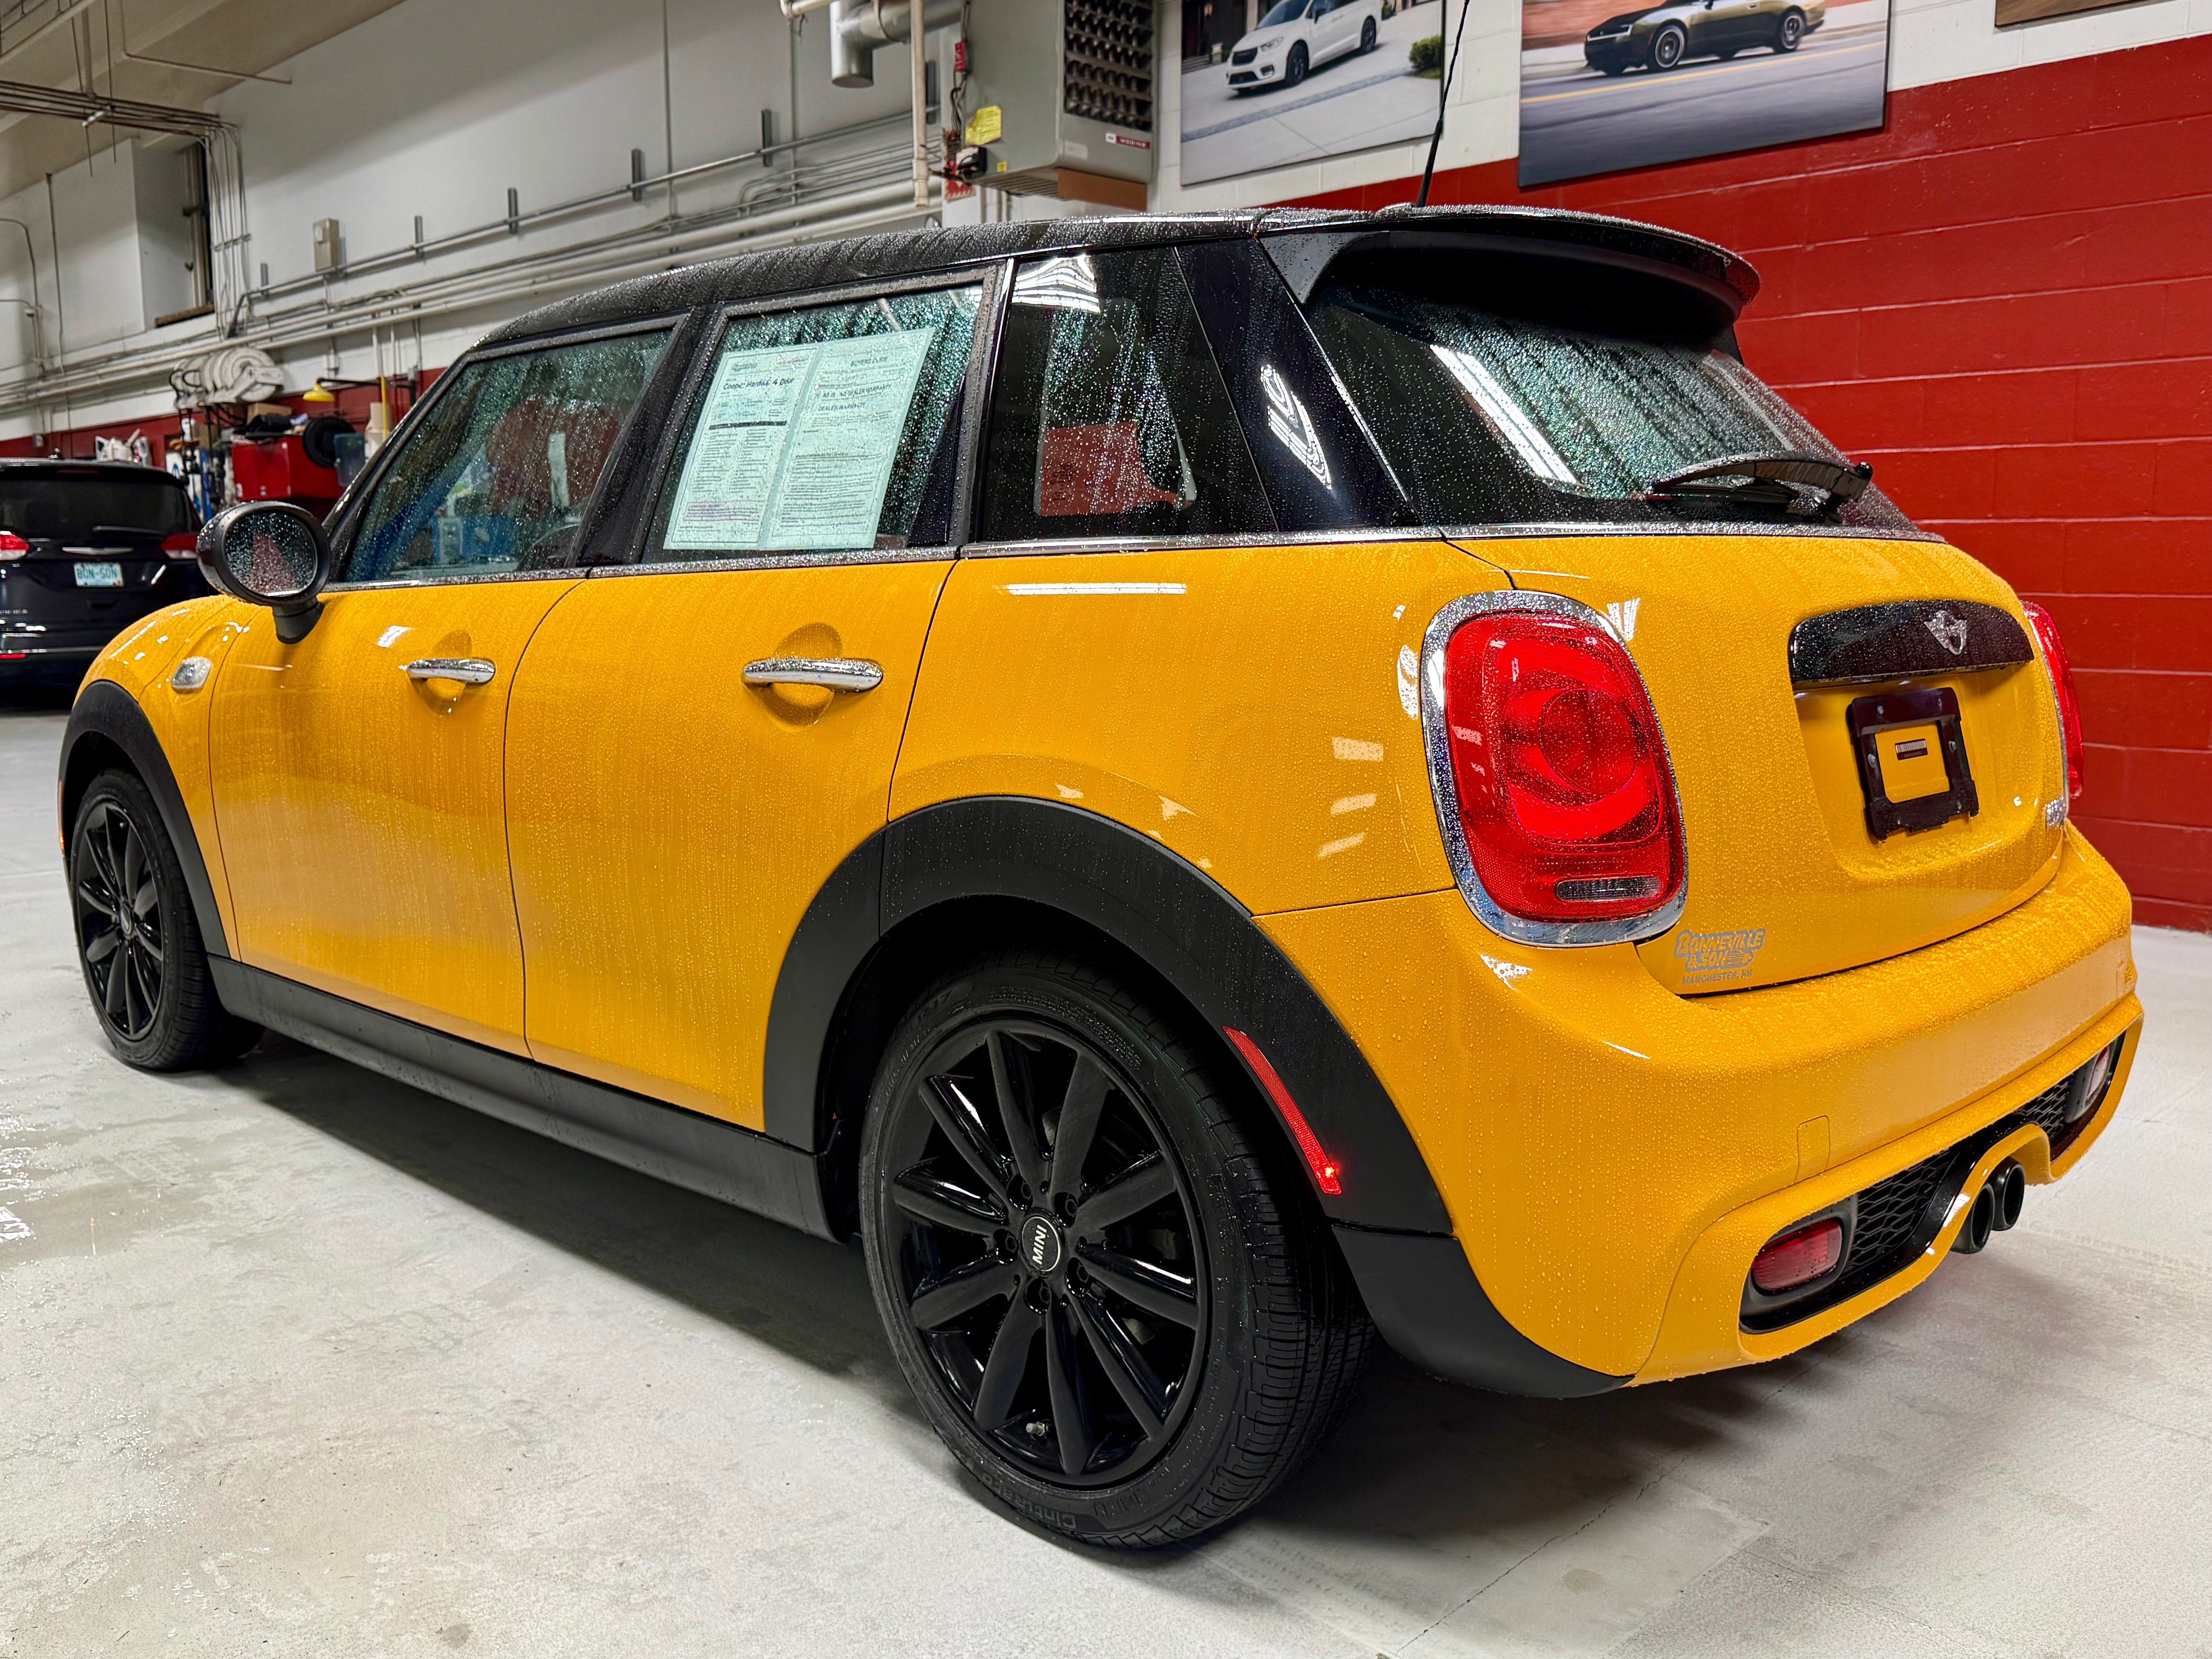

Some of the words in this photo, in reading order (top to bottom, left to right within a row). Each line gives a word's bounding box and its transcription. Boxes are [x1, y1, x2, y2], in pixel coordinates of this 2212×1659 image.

[77, 567, 117, 579] BON-SON
[1676, 931, 1764, 955] BONNEVILLE
[1699, 951, 1727, 967] SON
[1741, 969, 1753, 978] NH
[1032, 1224, 1047, 1265] MINI
